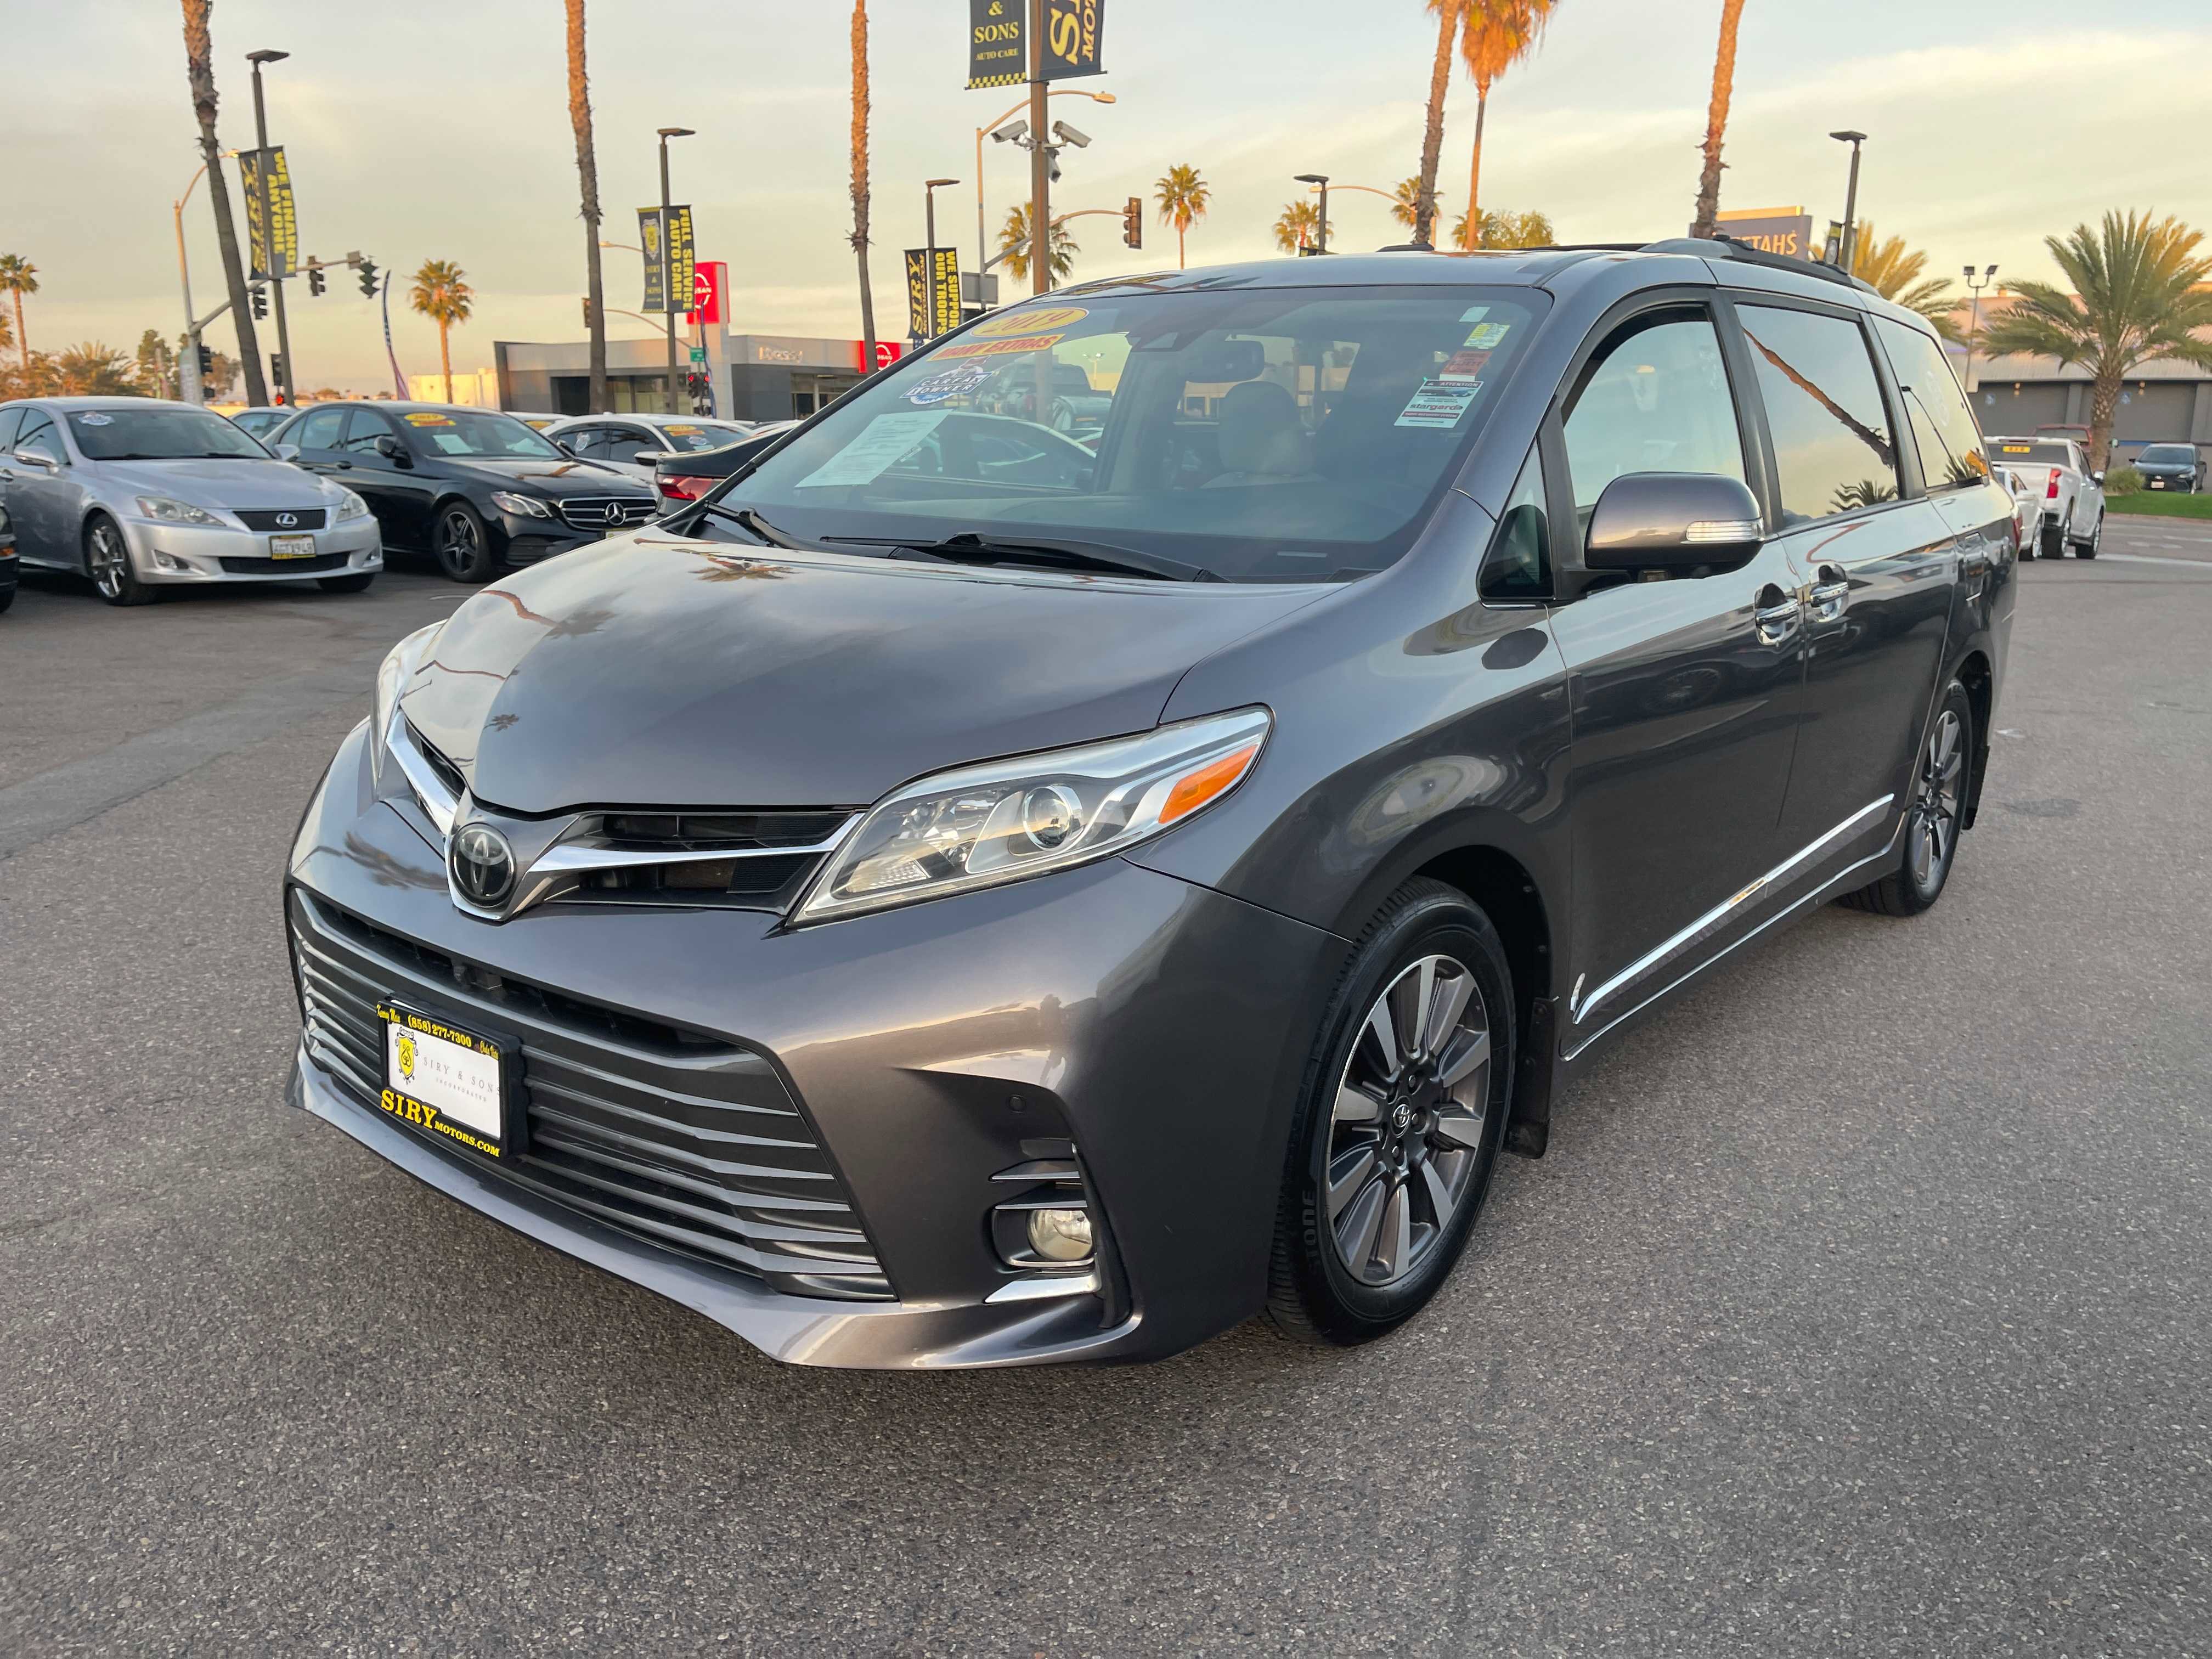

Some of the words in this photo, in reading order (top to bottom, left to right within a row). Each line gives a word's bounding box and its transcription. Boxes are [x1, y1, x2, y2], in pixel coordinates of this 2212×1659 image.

[988, 1, 1003, 16] &
[974, 21, 1019, 43] SONS
[974, 51, 997, 61] AUTO
[997, 48, 1019, 59] CARE
[274, 151, 288, 184] WE
[267, 174, 285, 254] ANYONE
[679, 209, 692, 242] FULL
[280, 189, 297, 274] FINANCE
[669, 219, 681, 259] AUTO
[935, 252, 946, 280] OUR
[946, 251, 957, 273] WE
[672, 262, 682, 301] CARE
[682, 248, 693, 310] SERVICE
[907, 253, 923, 335] SIRY
[936, 283, 948, 335] TROOPS
[947, 275, 960, 331] SUPPOR
[983, 336, 1057, 354] EXTRAS
[919, 385, 973, 393] OWNER
[921, 376, 984, 386] CARFAX
[408, 1014, 431, 1034] (858)
[432, 1024, 472, 1048] 277-7300
[423, 1057, 449, 1075] SIRY
[458, 1071, 463, 1080] &
[380, 1089, 437, 1129] SIRY
[434, 1120, 500, 1158] MOTORS.COM
